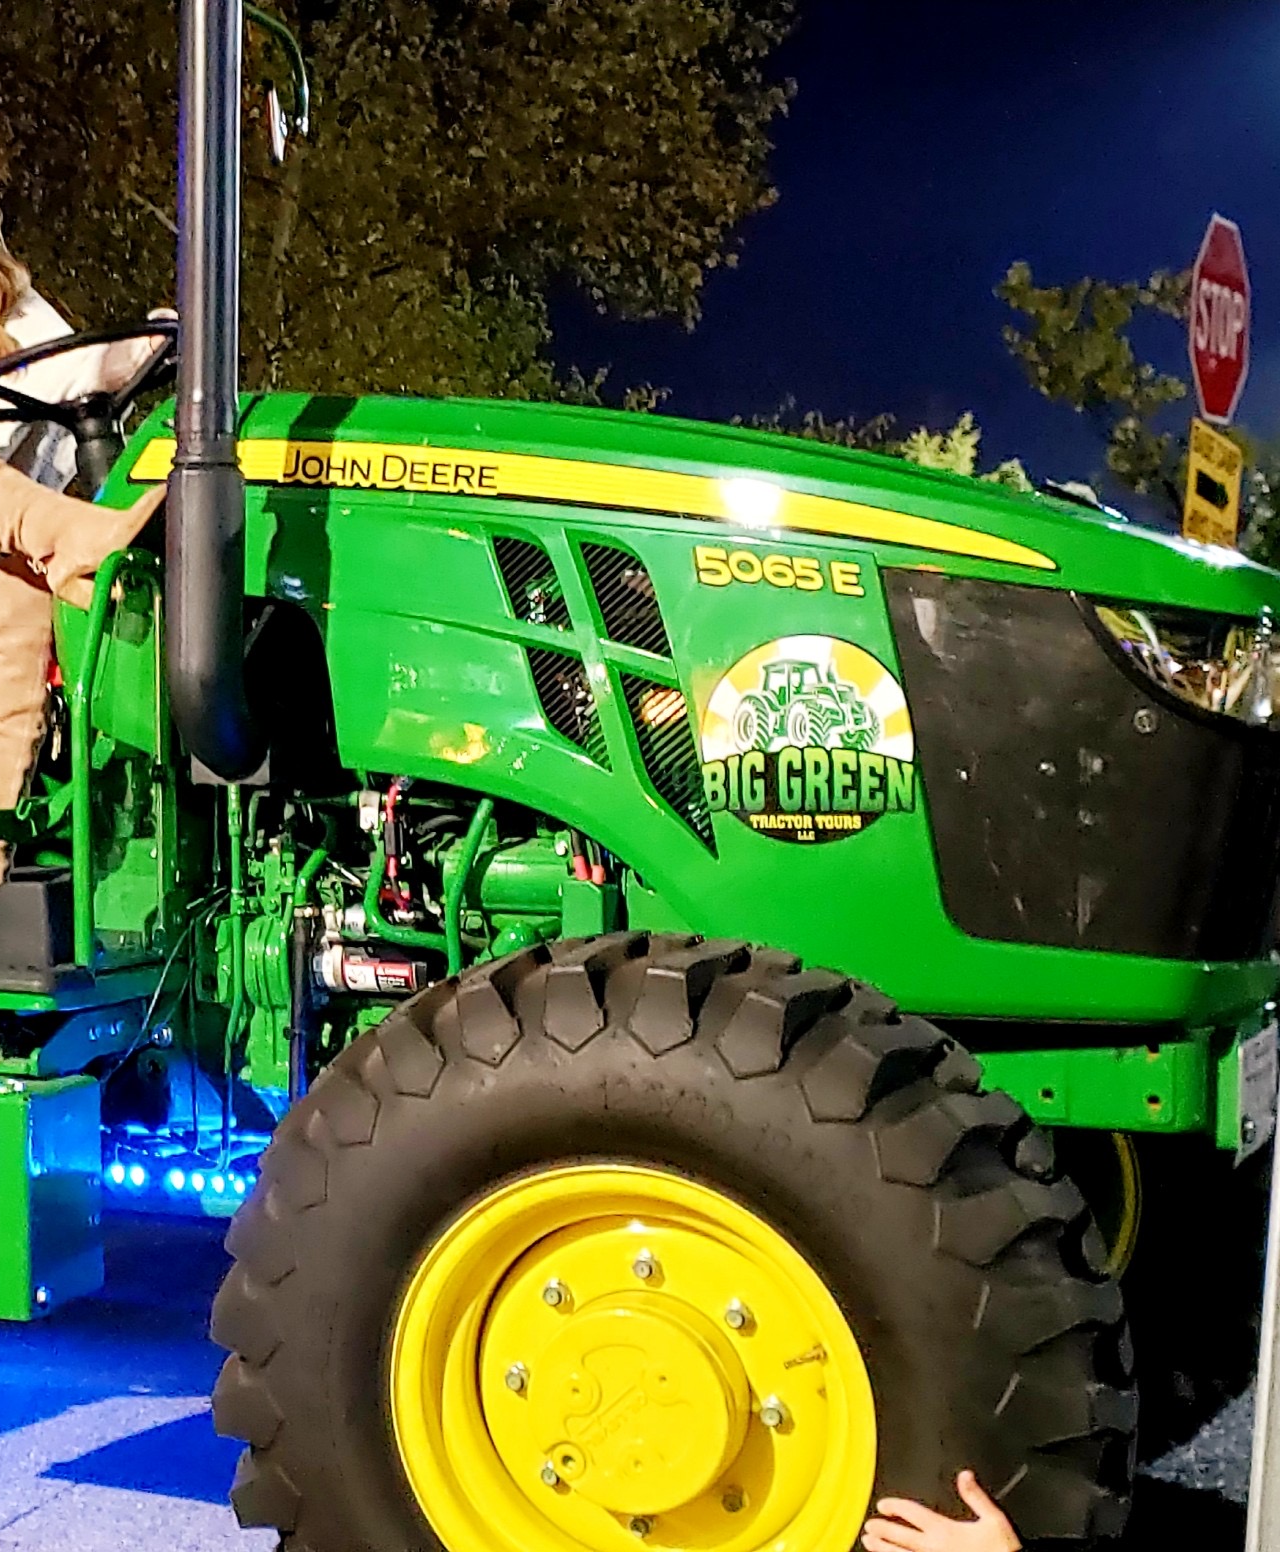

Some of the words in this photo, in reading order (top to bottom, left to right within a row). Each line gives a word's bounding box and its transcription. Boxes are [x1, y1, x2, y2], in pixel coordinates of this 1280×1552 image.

[1196, 277, 1245, 361] STOP
[283, 449, 371, 481] JOHN
[382, 455, 499, 489] DEERE
[694, 545, 824, 591] 5065
[830, 560, 866, 597] E
[701, 749, 766, 812] BIG
[777, 745, 916, 814] GREEN
[749, 814, 813, 829] TRACTOR
[815, 814, 862, 830] TOURS
[797, 830, 816, 841] LLC
